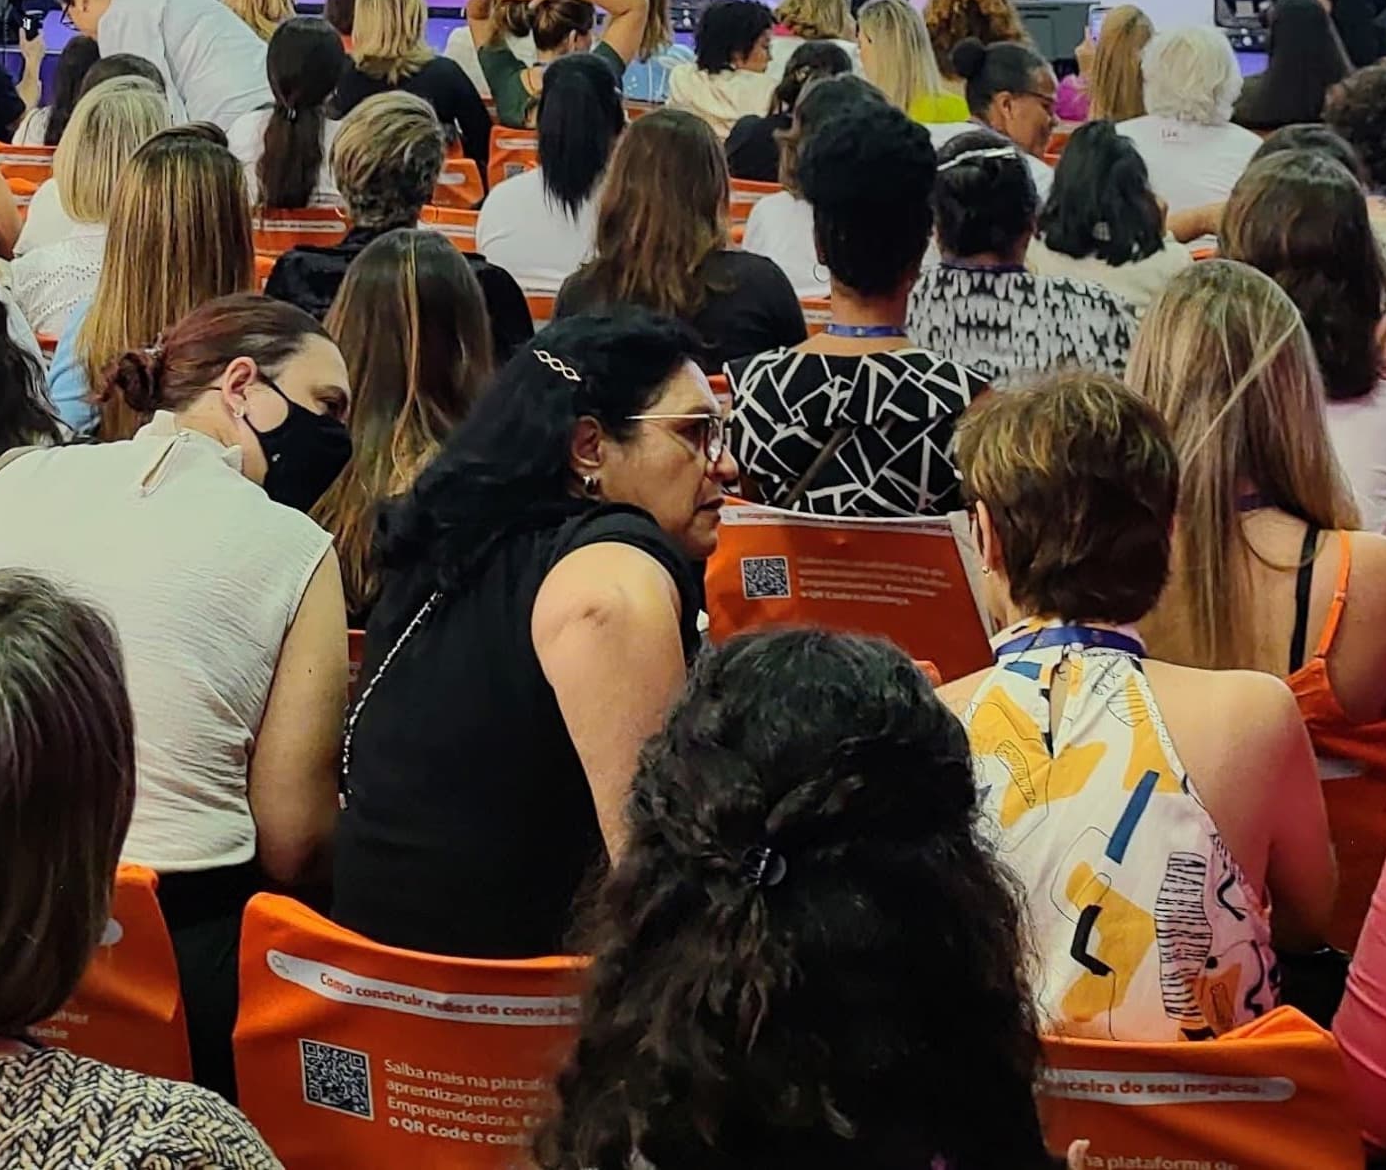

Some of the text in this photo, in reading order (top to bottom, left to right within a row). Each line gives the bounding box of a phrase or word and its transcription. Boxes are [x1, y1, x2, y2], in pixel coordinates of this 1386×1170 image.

[319, 972, 353, 996] Como
[355, 986, 424, 1007] construir
[476, 1003, 500, 1016] de
[383, 1058, 425, 1080] Saiba
[426, 1068, 465, 1086] mais
[466, 1075, 489, 1089] na
[1119, 1080, 1143, 1094] do
[1146, 1083, 1180, 1094] seu
[385, 1079, 500, 1109] aprendizagem
[504, 1095, 525, 1109] do
[388, 1115, 399, 1128] o
[400, 1118, 426, 1134] QR
[427, 1121, 471, 1142] Code
[473, 1132, 484, 1142] e
